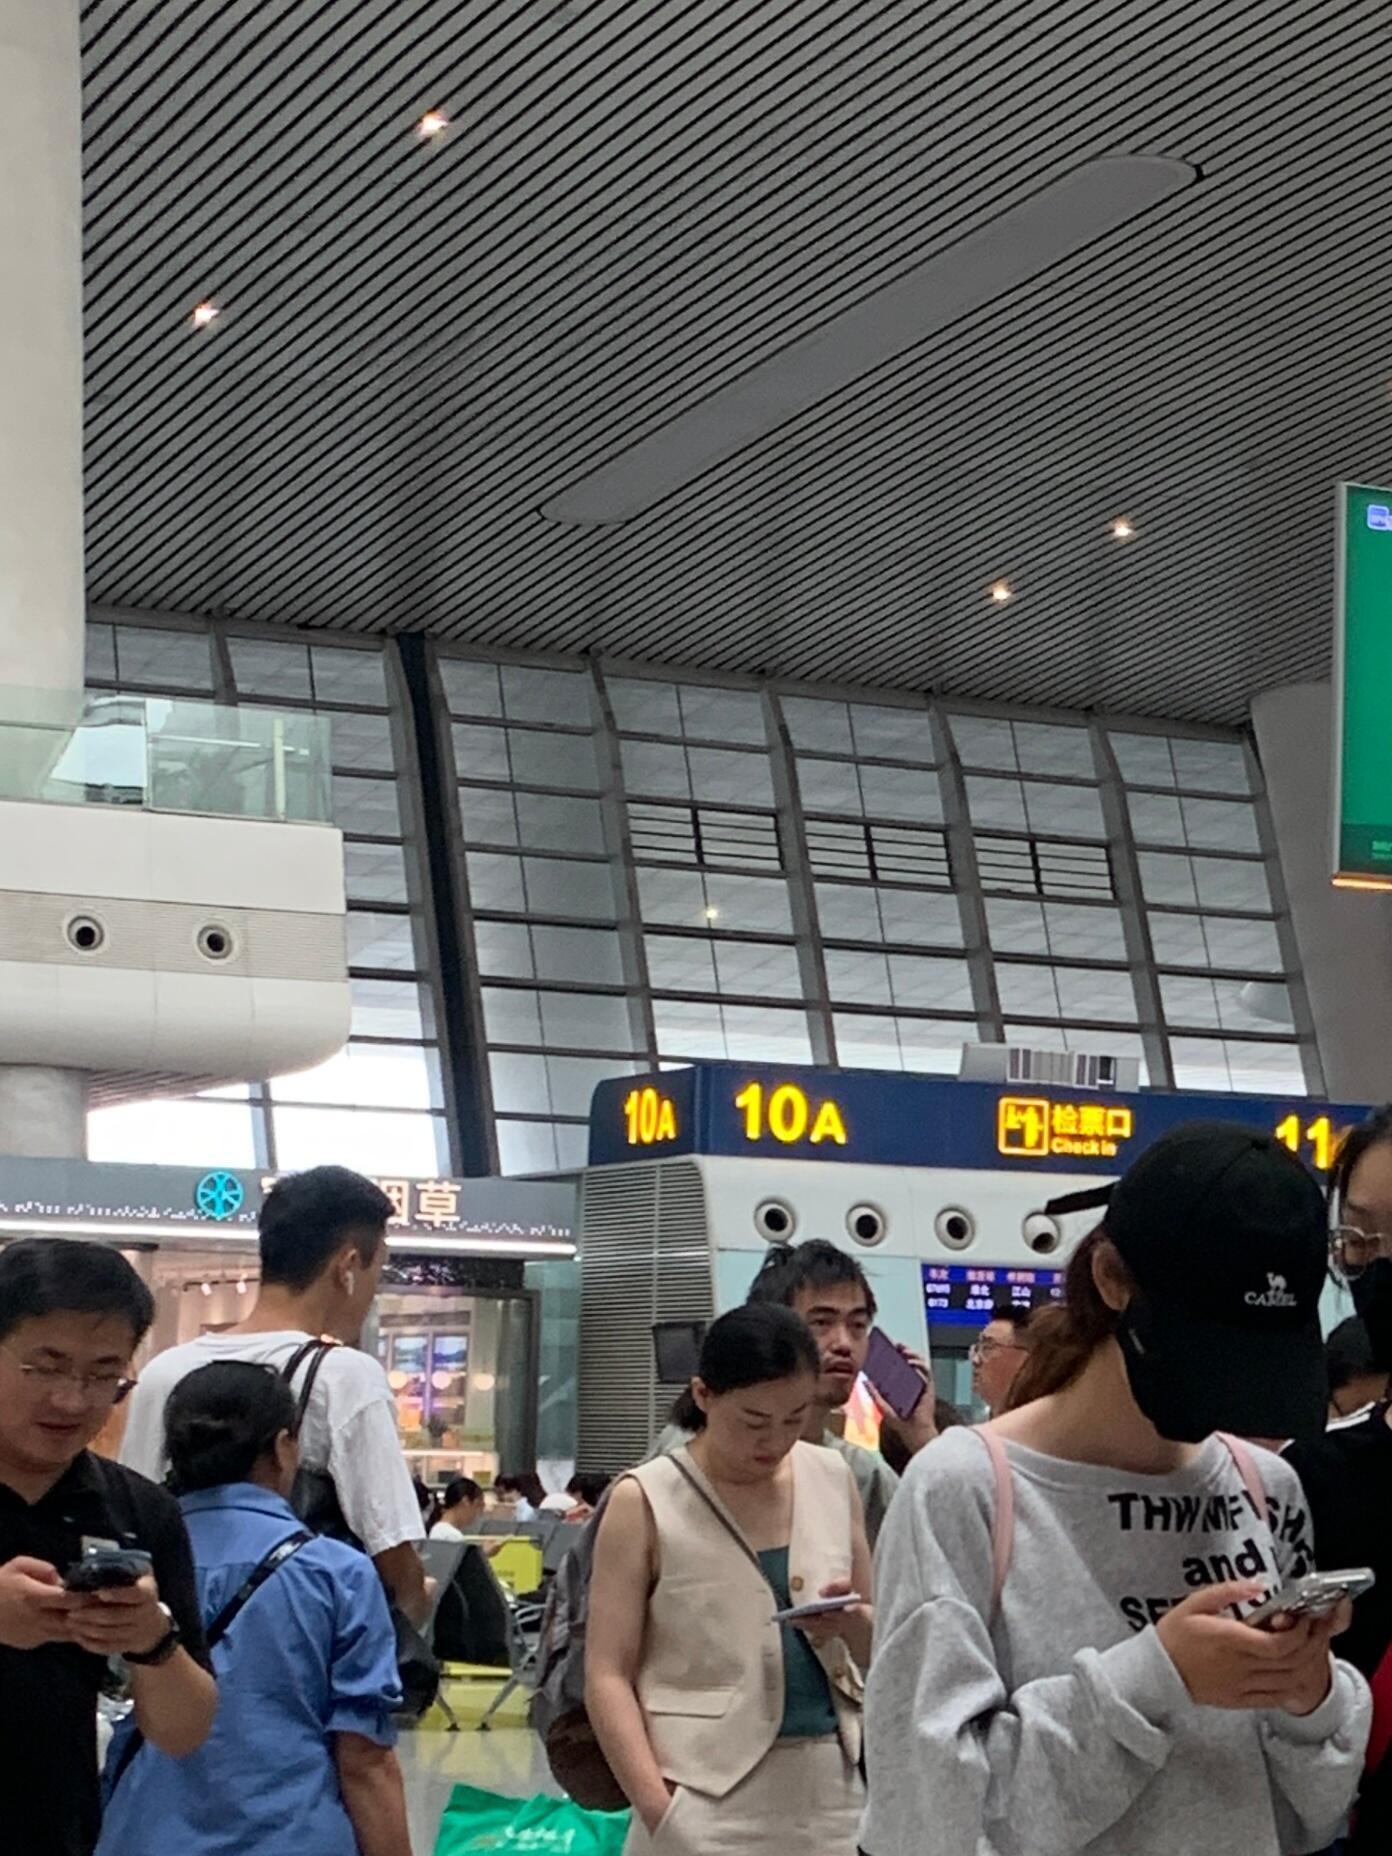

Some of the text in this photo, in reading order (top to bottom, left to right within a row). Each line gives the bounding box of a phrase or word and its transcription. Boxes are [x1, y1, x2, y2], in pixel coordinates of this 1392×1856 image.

[624, 1087, 677, 1145] 10A
[735, 1082, 847, 1145] 10A
[1052, 1103, 1132, 1139] 检票口
[1274, 1113, 1337, 1170] 11
[1182, 1537, 1268, 1587] and
